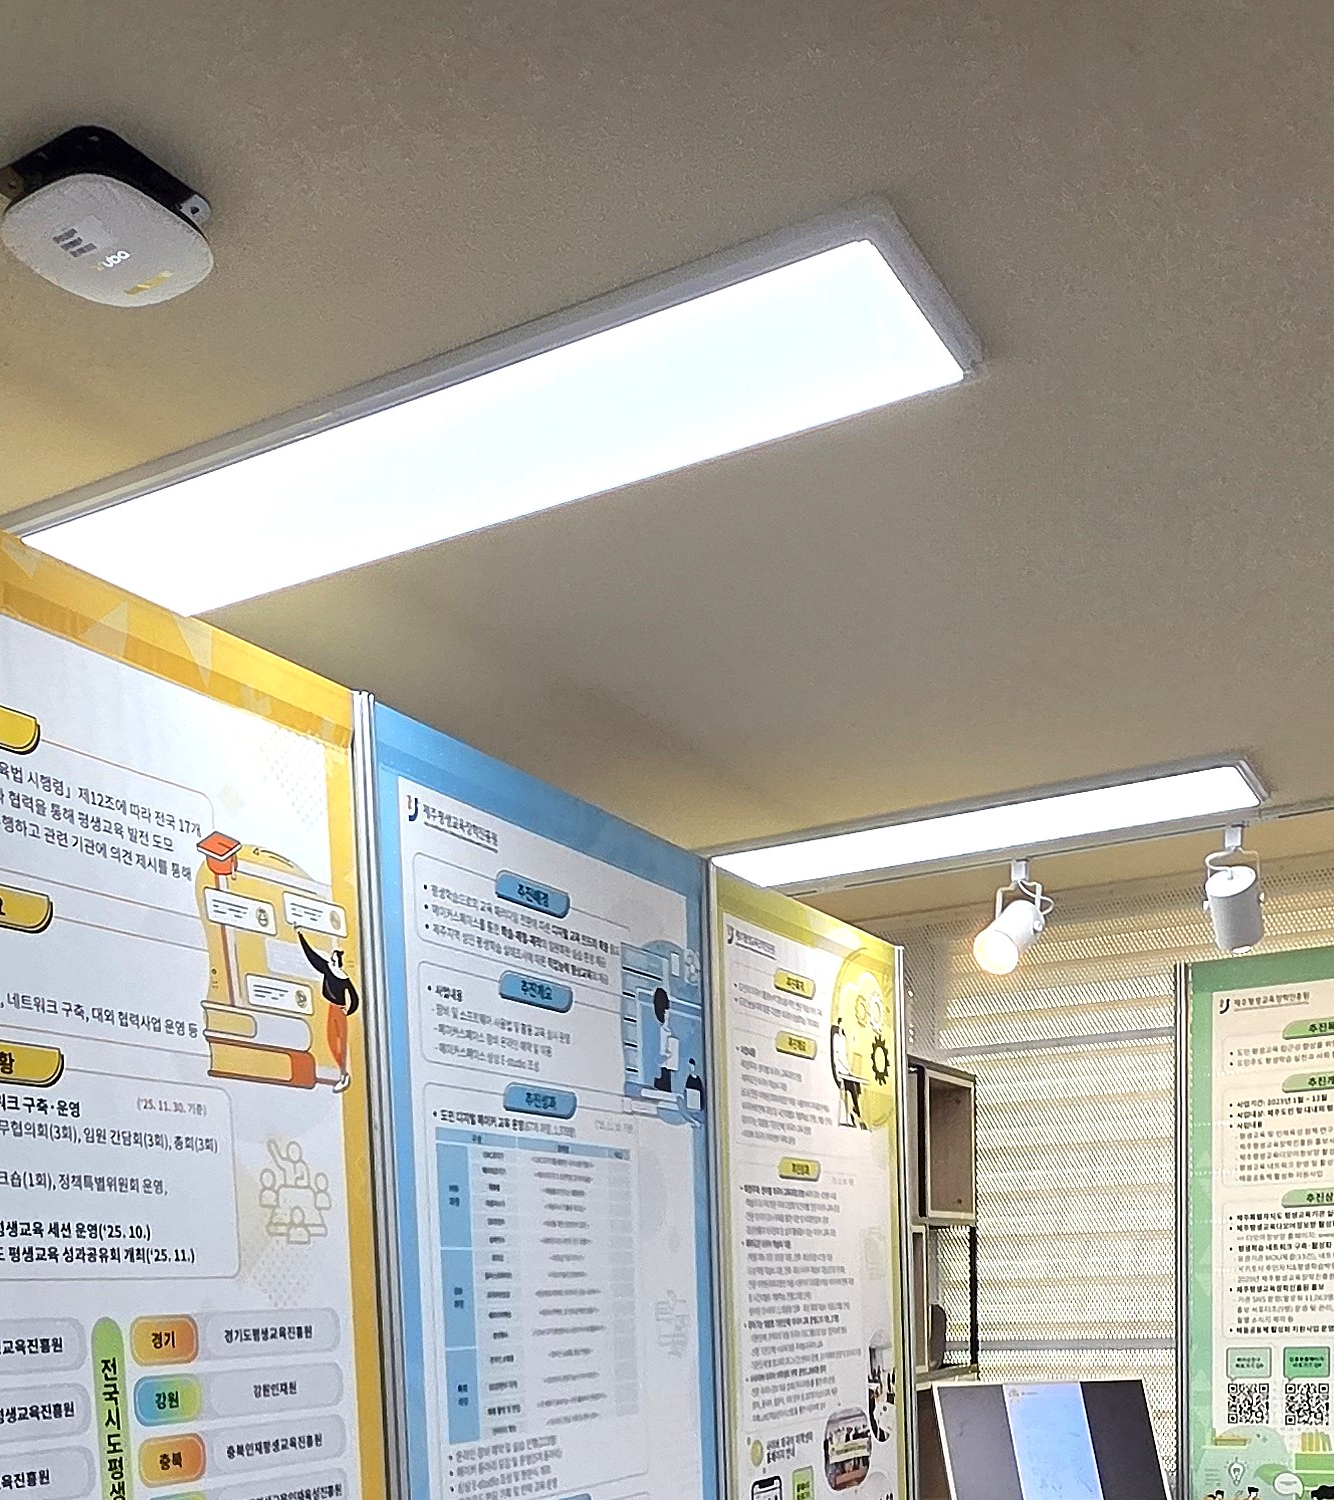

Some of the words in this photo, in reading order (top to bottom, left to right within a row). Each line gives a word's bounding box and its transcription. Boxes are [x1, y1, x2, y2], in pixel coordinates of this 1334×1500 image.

[27, 771, 70, 799] 시행령」
[77, 787, 127, 816] 제12조에
[129, 803, 151, 823] 따라
[154, 811, 175, 830] 전국
[178, 818, 201, 838] 17개
[47, 1221, 71, 1238] 세션
[151, 1330, 175, 1349] 경기
[155, 1390, 179, 1409] 강원
[159, 1451, 182, 1470] 충북
